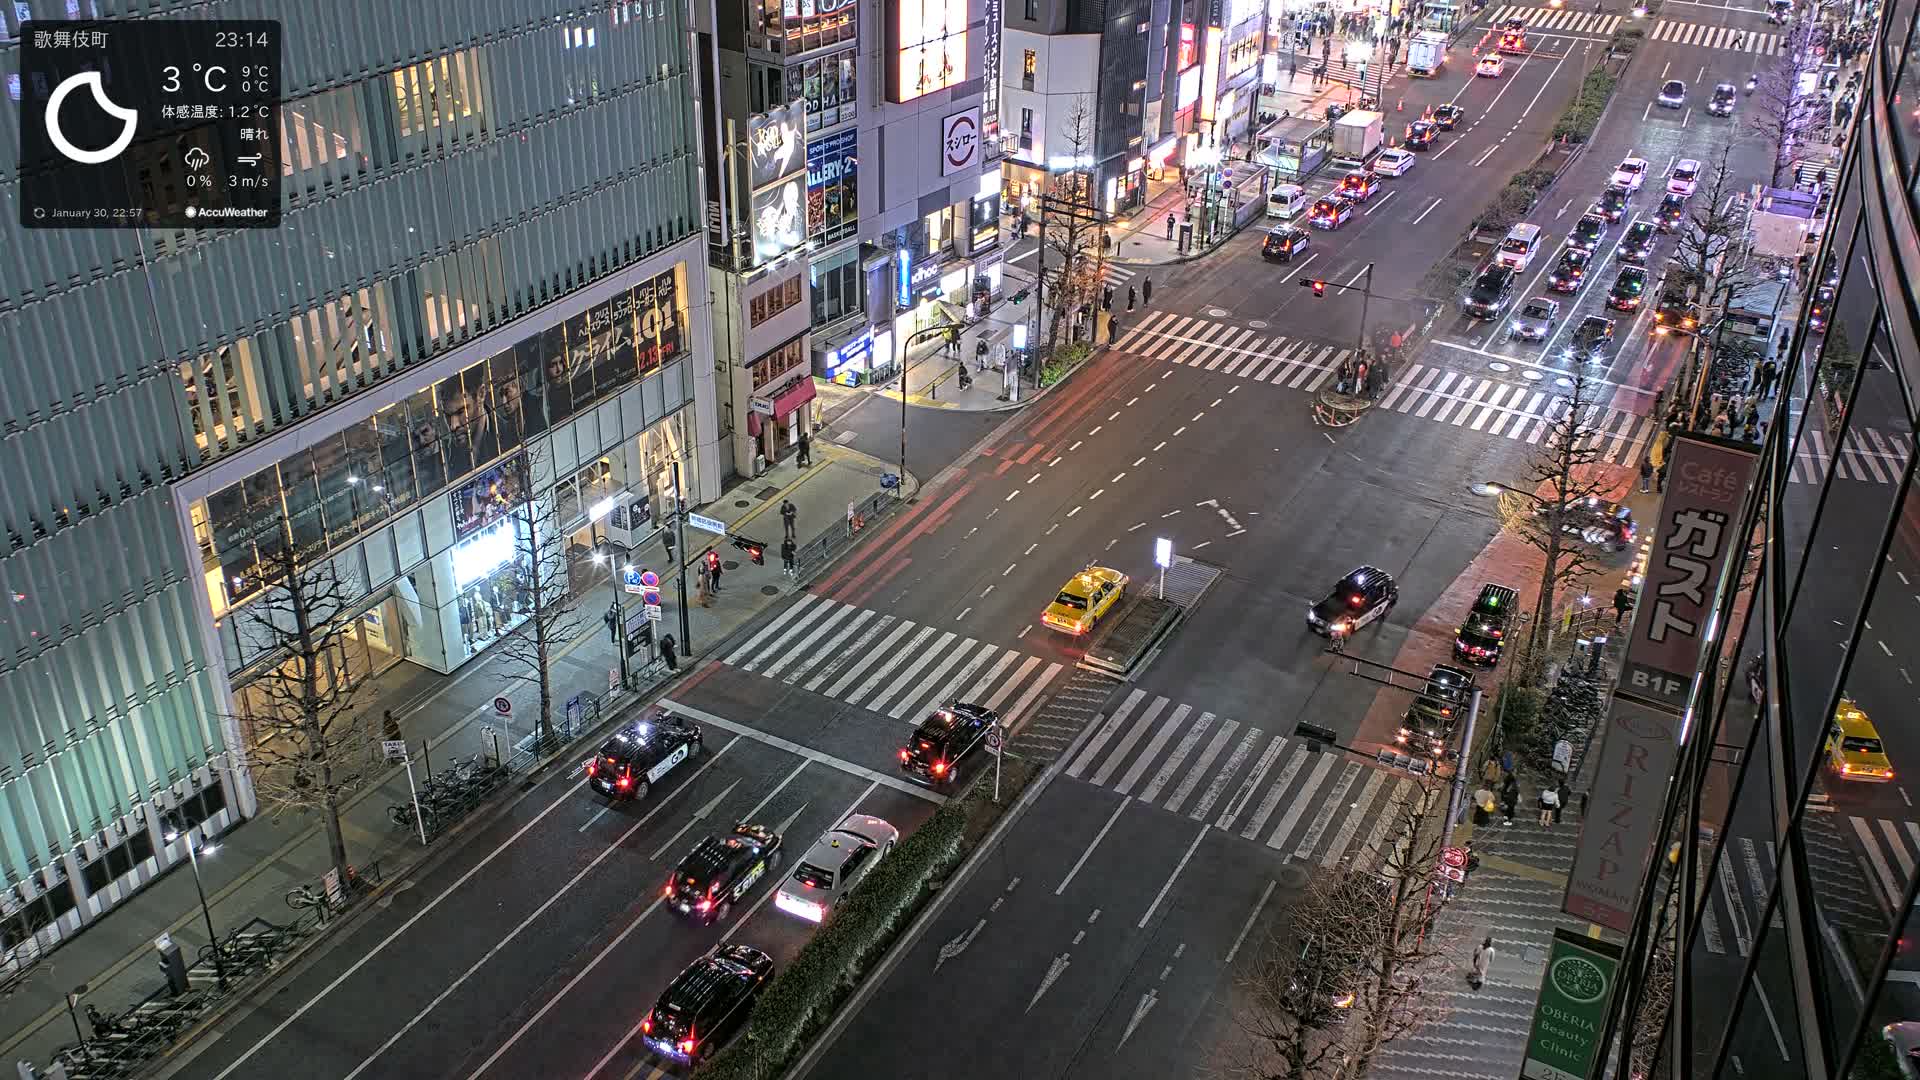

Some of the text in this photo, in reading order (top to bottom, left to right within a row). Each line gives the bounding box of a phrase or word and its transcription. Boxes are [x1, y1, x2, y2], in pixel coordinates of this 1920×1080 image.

[945, 133, 977, 153] スシロー
[708, 200, 721, 234] MUJI
[1650, 508, 1728, 643] ガスト
[1631, 670, 1681, 696] B1F
[1599, 742, 1650, 882] RIZAP
[1541, 1004, 1595, 1033] OBERIA
[1541, 1020, 1589, 1047] Beauty
[1540, 1039, 1581, 1061] Clinic
